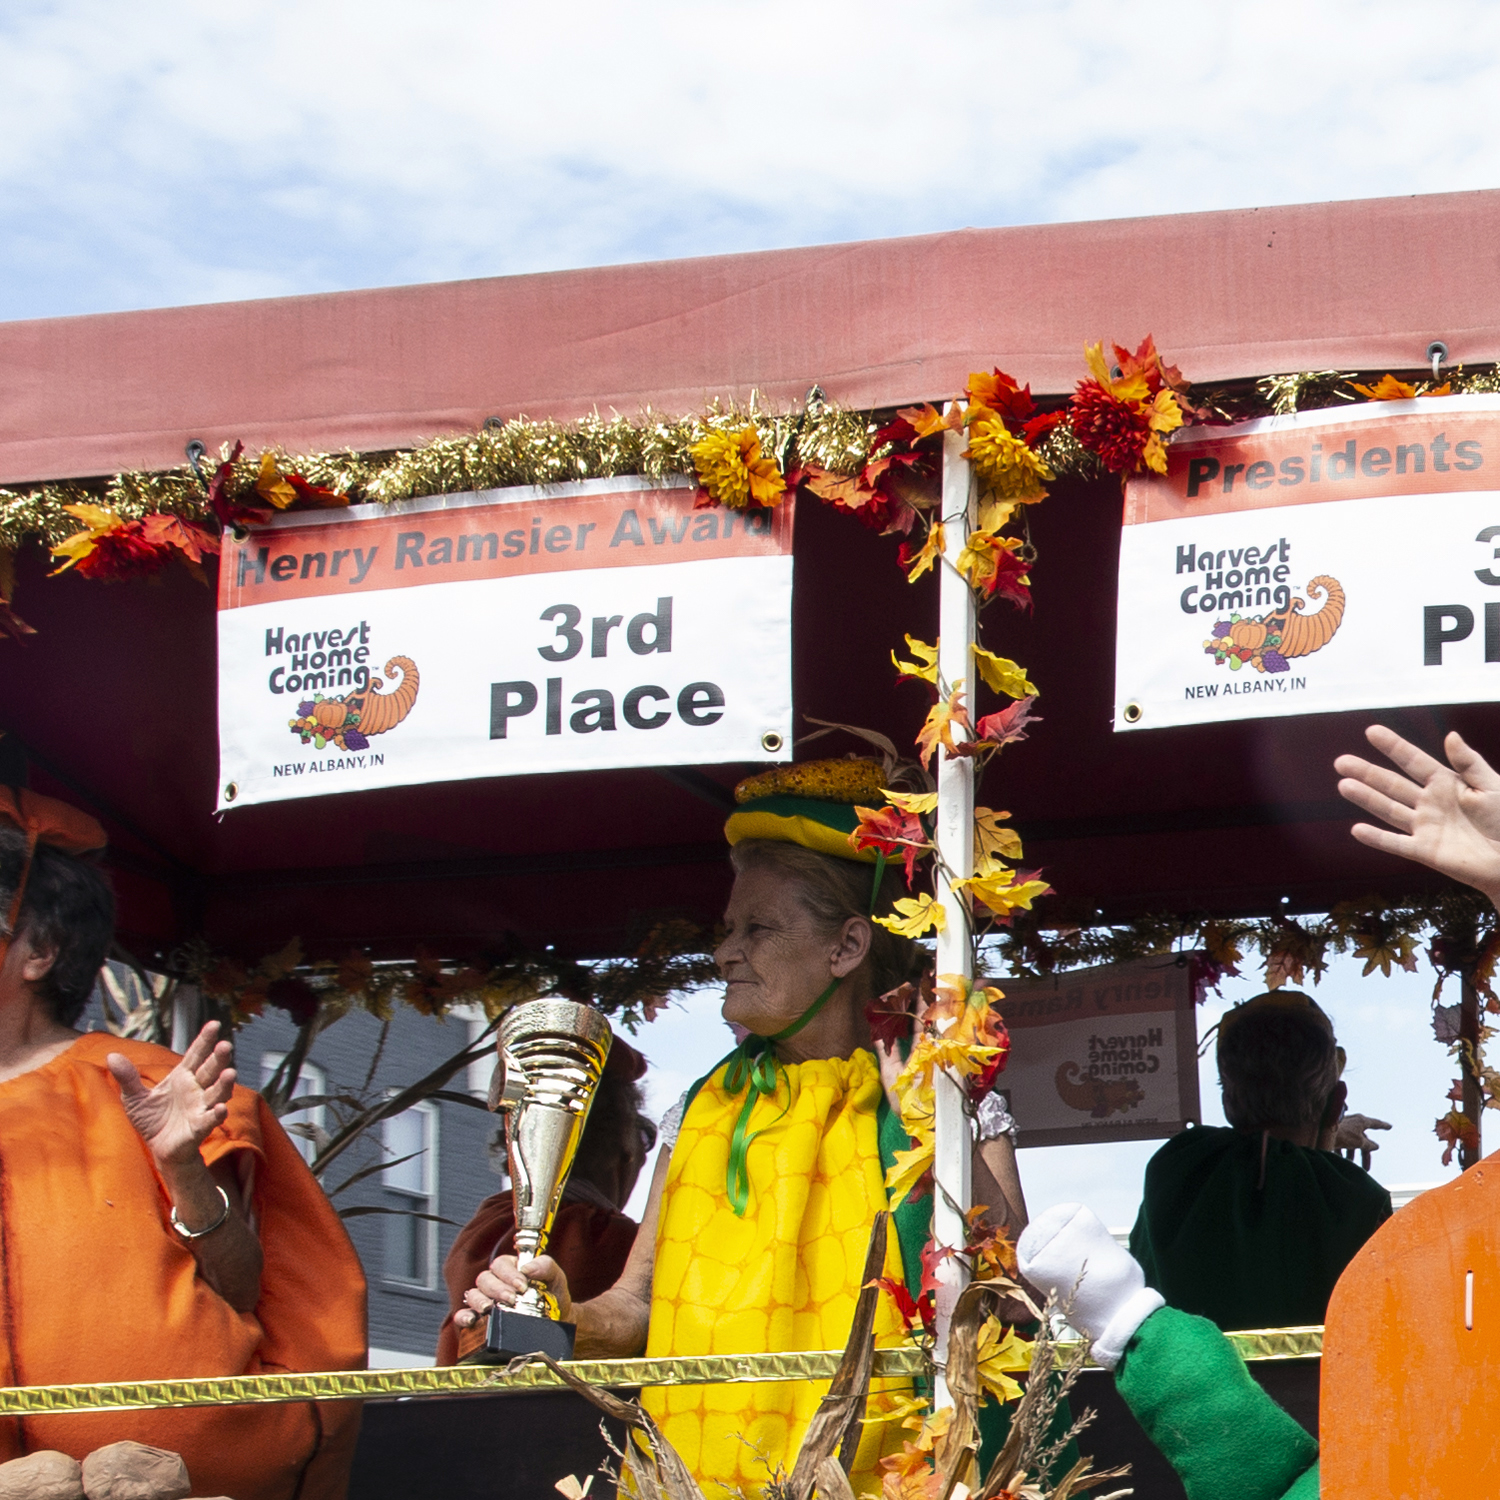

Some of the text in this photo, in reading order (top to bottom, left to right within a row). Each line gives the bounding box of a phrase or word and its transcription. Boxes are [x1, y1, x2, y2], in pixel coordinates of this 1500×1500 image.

[1186, 431, 1484, 498] Presidents
[236, 507, 773, 587] Henry Ramsier Award
[1175, 537, 1291, 575] Harvest
[1205, 564, 1291, 591] Home
[1180, 584, 1291, 615] Coming
[265, 620, 371, 657] Harvest
[537, 596, 674, 663] 3rd
[291, 646, 370, 672] Home
[269, 665, 370, 695] Coming
[1185, 677, 1307, 700] NEW ALBANY, IN
[489, 677, 726, 741] Place
[273, 753, 385, 778] NEW ALBANY, IN
